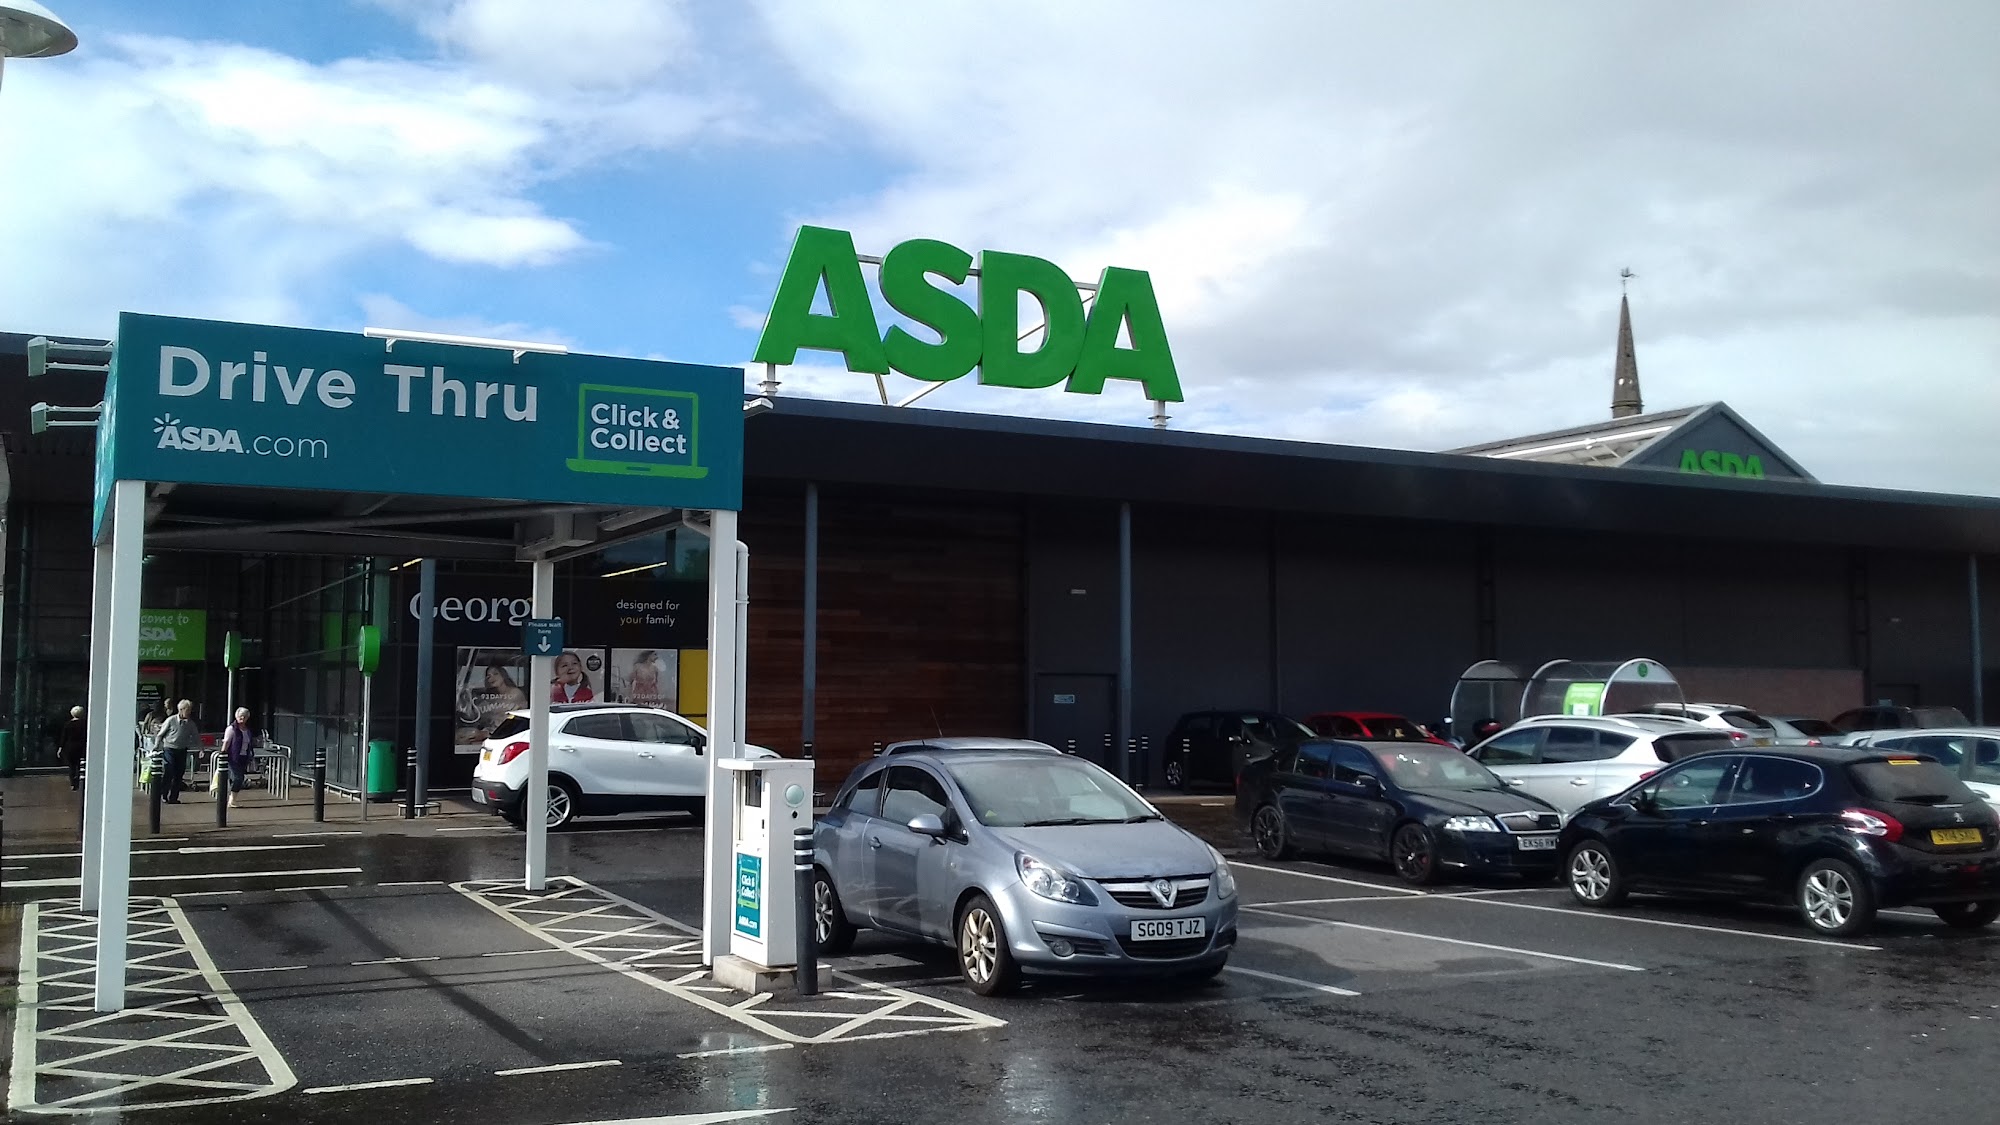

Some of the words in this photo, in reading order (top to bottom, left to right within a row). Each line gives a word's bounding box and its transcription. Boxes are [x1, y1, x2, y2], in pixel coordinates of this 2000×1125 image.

[752, 224, 1184, 402] ASDA
[159, 345, 356, 408] Drive
[384, 363, 537, 422] Thru
[591, 403, 659, 428] Click
[662, 408, 680, 430] &
[154, 420, 328, 459] ASDA.com
[590, 427, 687, 454] Collect
[1680, 448, 1765, 480] ASDA
[409, 590, 561, 627] Georg
[616, 599, 663, 612] designed
[665, 600, 680, 610] for
[140, 614, 173, 624] come
[177, 613, 189, 625] to
[620, 616, 643, 626] your
[645, 614, 676, 628] family
[139, 627, 177, 641] SDA
[139, 644, 174, 657] orfar
[741, 886, 755, 899] Collect
[1138, 921, 1173, 937] SG09
[1177, 919, 1200, 936] TJZ
